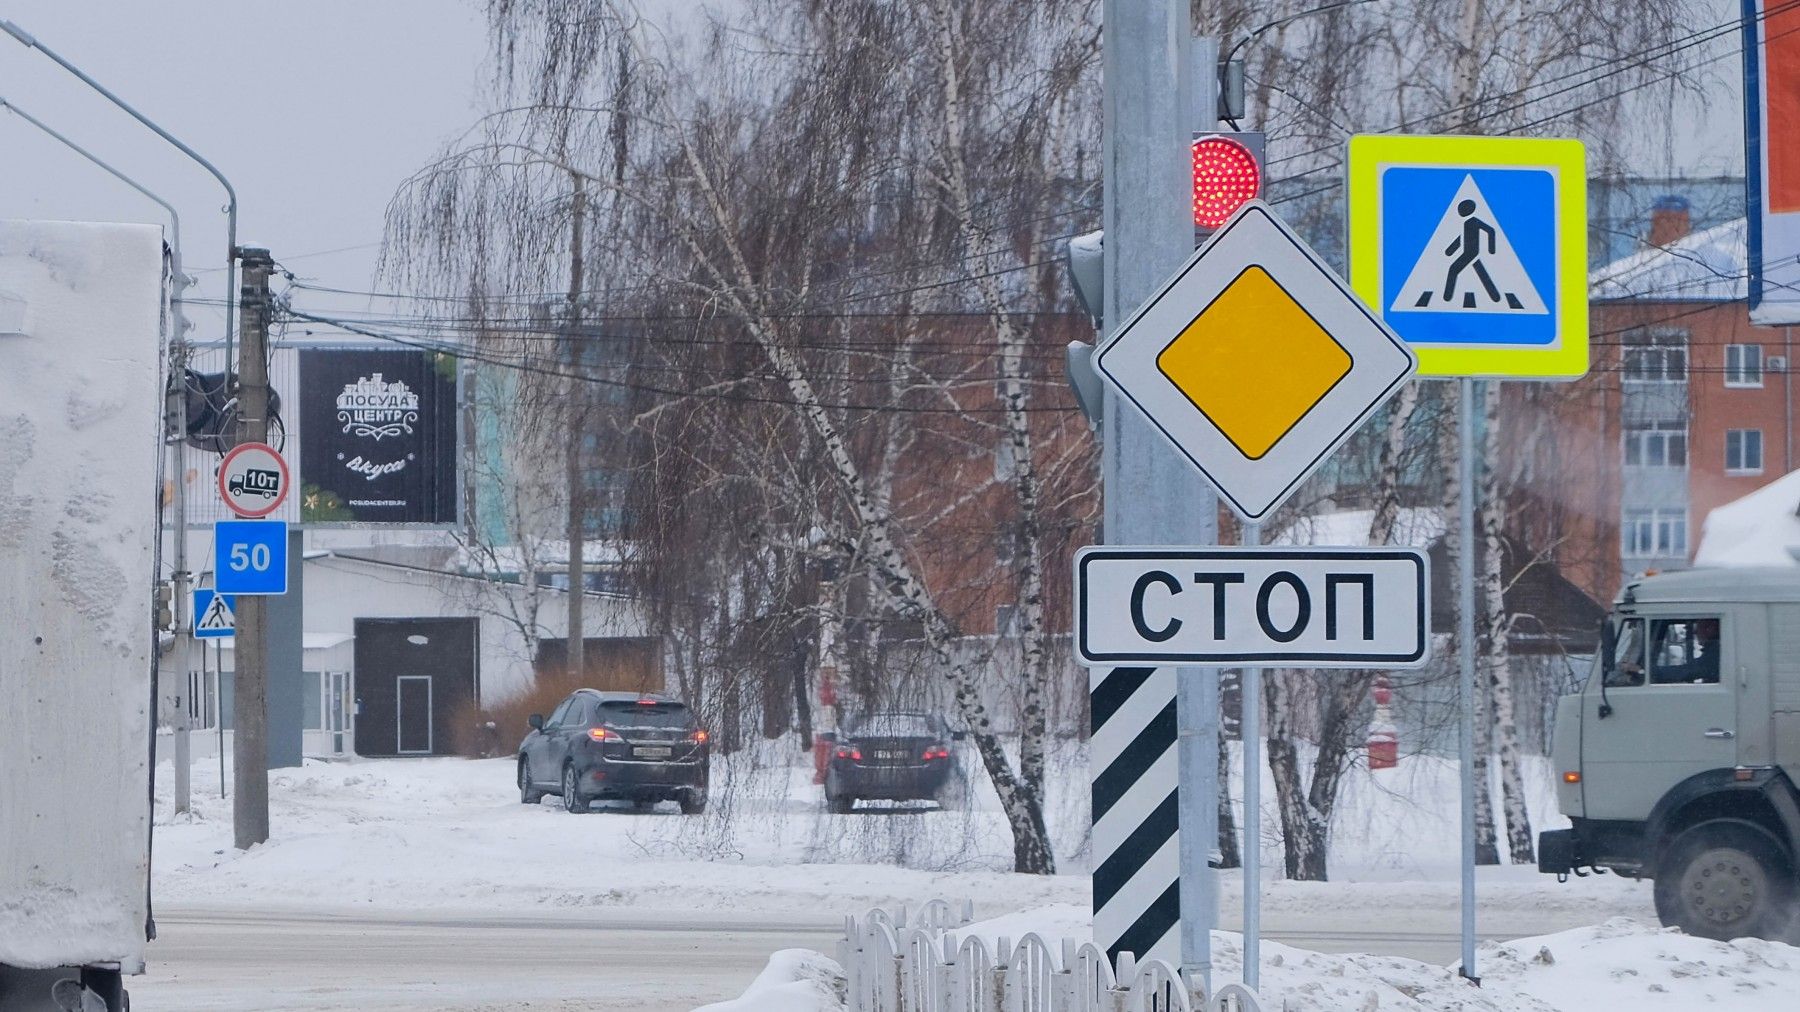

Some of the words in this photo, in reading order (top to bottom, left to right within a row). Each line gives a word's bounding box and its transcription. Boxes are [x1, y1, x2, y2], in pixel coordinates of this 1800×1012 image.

[346, 395, 410, 408] ПОСУДА
[354, 410, 403, 423] ЦЕНТР
[229, 543, 271, 572] 50
[1130, 570, 1374, 642] СТОП
